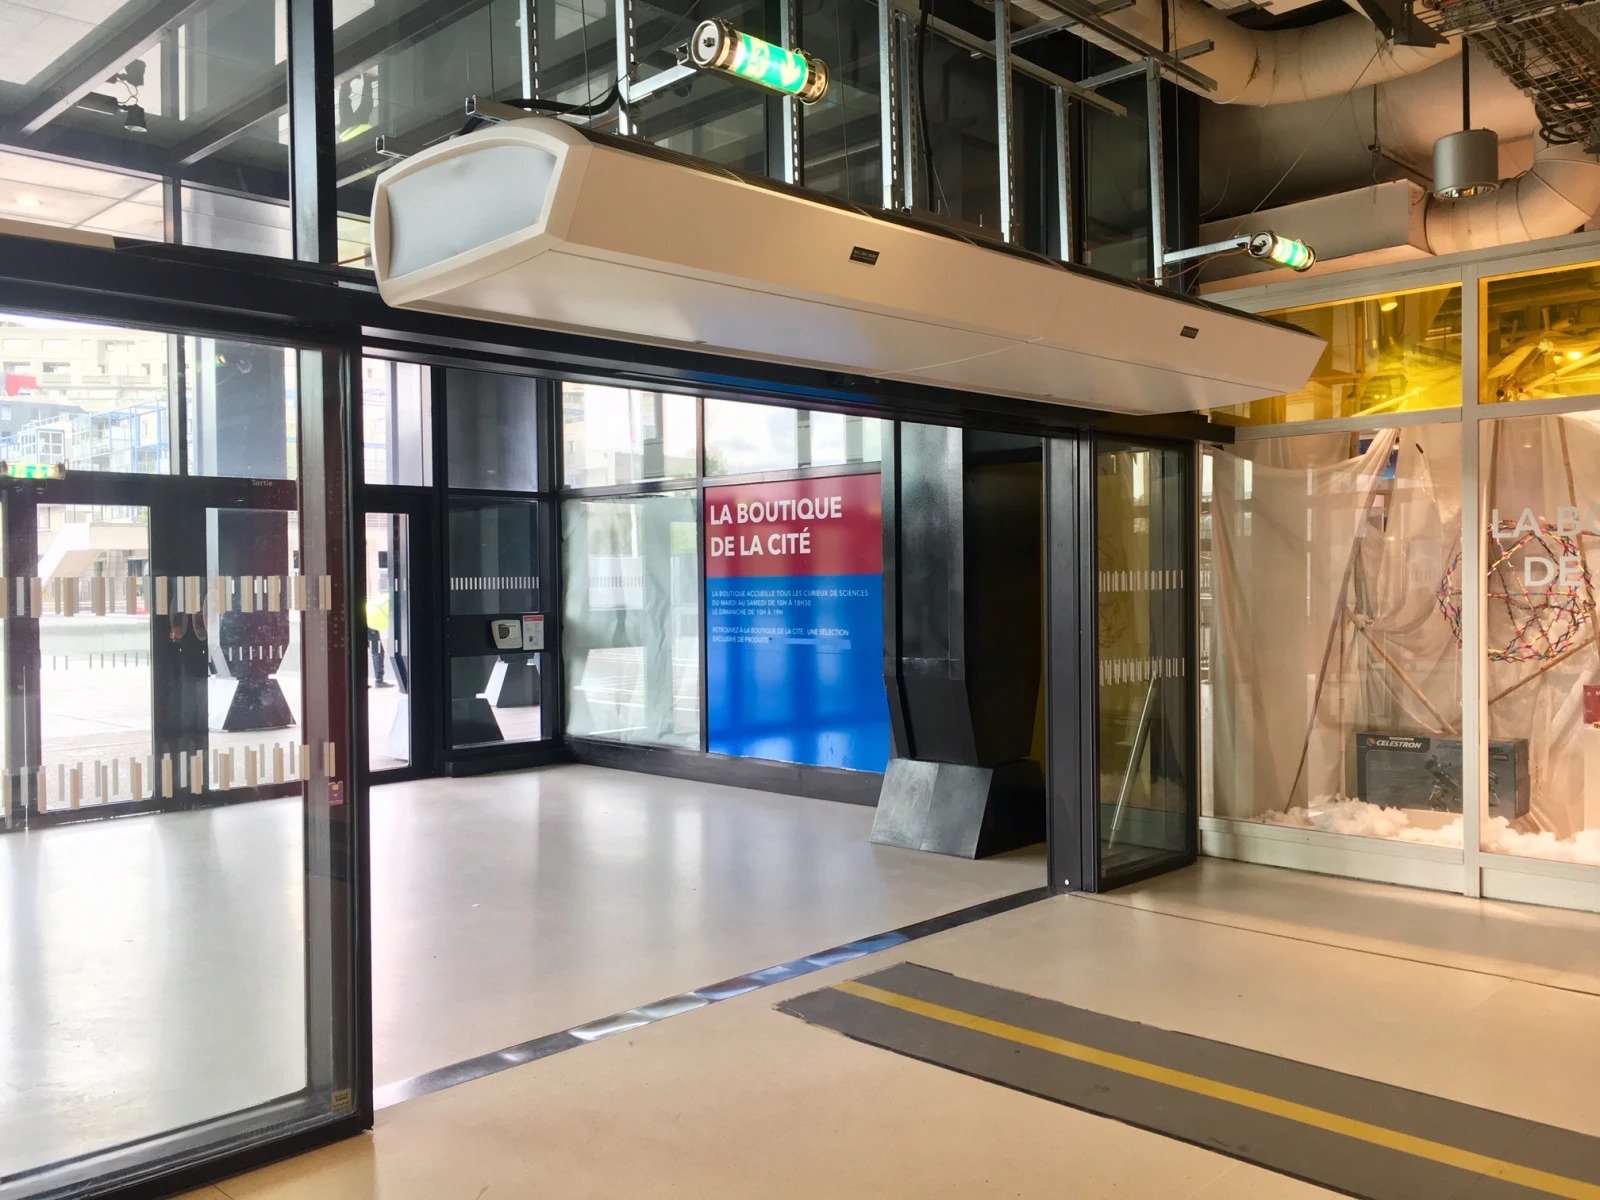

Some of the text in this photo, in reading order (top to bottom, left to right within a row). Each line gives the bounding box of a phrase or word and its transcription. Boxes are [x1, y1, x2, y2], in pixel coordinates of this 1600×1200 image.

[710, 496, 843, 526] LA BOUTIQUE
[1492, 507, 1545, 539] LA
[711, 527, 811, 557] DE LA CITÉ
[1524, 555, 1582, 588] DE
[776, 589, 792, 597] TOUS
[792, 589, 803, 597] LES
[803, 589, 829, 597] CURIEUX
[829, 589, 838, 597] DE
[839, 589, 869, 597] SCIENCES
[794, 599, 812, 607] 18H30
[711, 608, 719, 616] LE
[719, 608, 747, 616] DIMANCHE
[747, 608, 755, 616] DE
[756, 608, 767, 616] 10H
[773, 608, 784, 616] 19H
[776, 627, 785, 635] DE
[806, 628, 819, 636] UNE
[1376, 739, 1422, 749] CELESTRON
